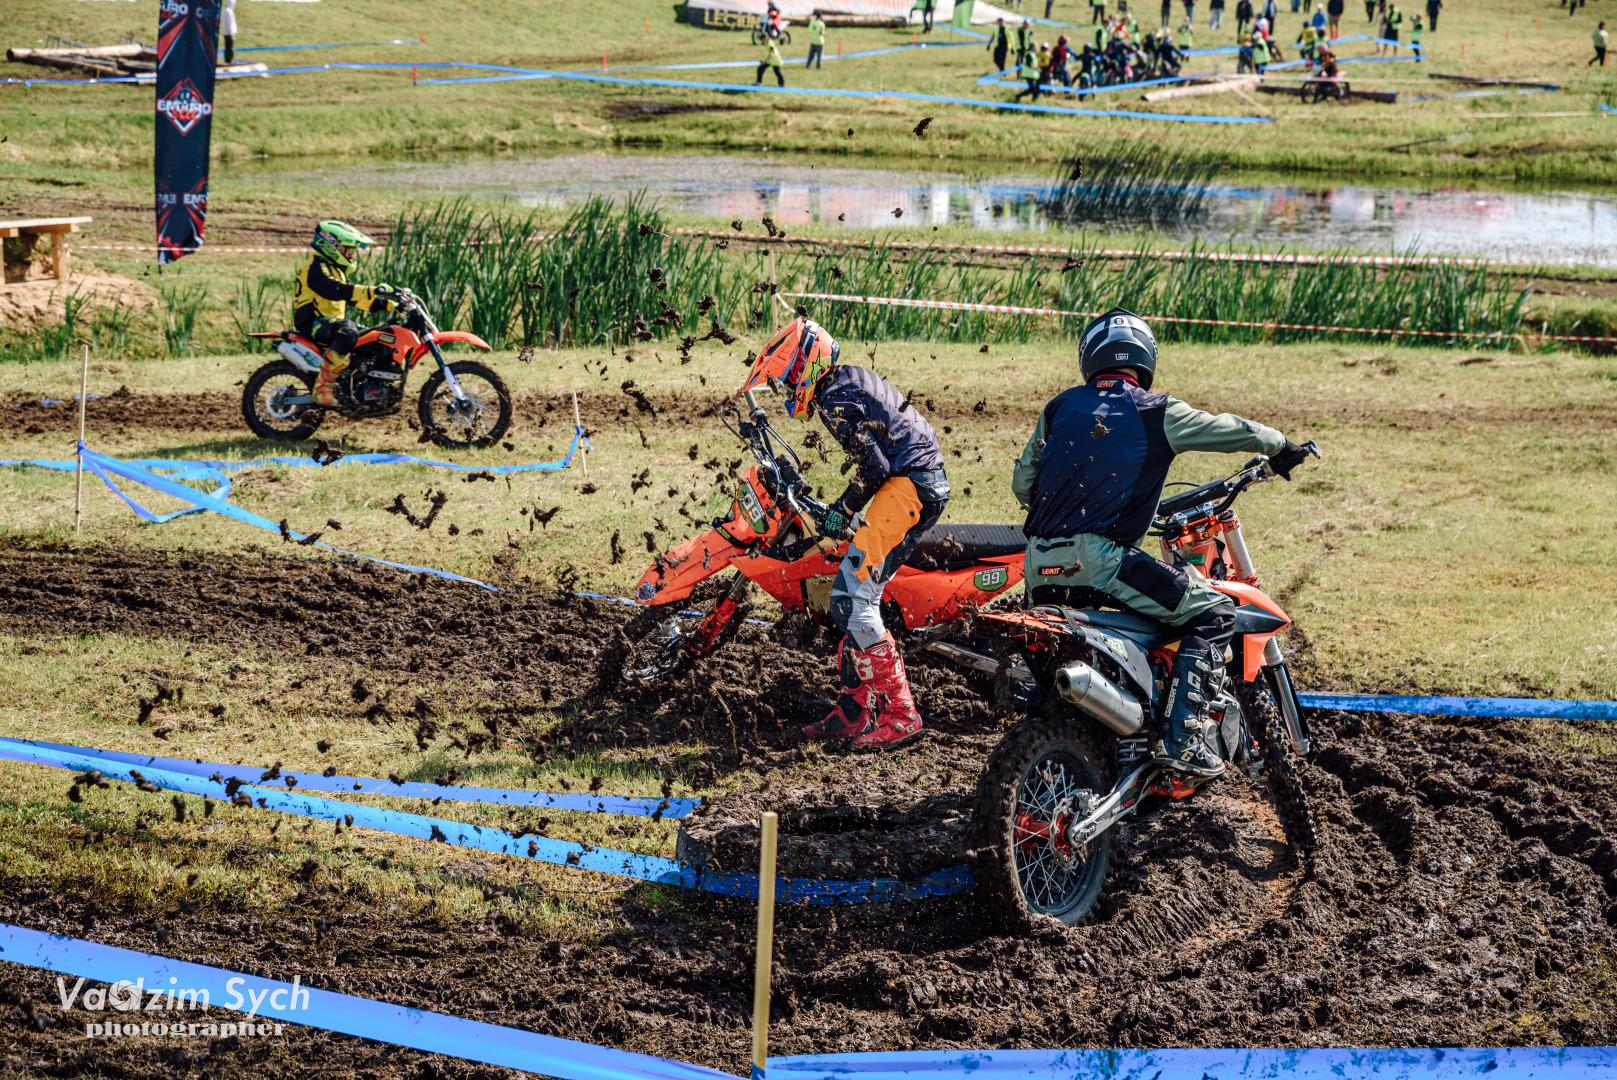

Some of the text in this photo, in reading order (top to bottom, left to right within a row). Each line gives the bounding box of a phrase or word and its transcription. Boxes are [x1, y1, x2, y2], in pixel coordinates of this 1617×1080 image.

[157, 99, 212, 114] ENDURO
[788, 345, 808, 386] LEATT
[1096, 380, 1118, 388] LEATT
[982, 571, 1000, 586] 99
[1041, 567, 1061, 576] LEATT
